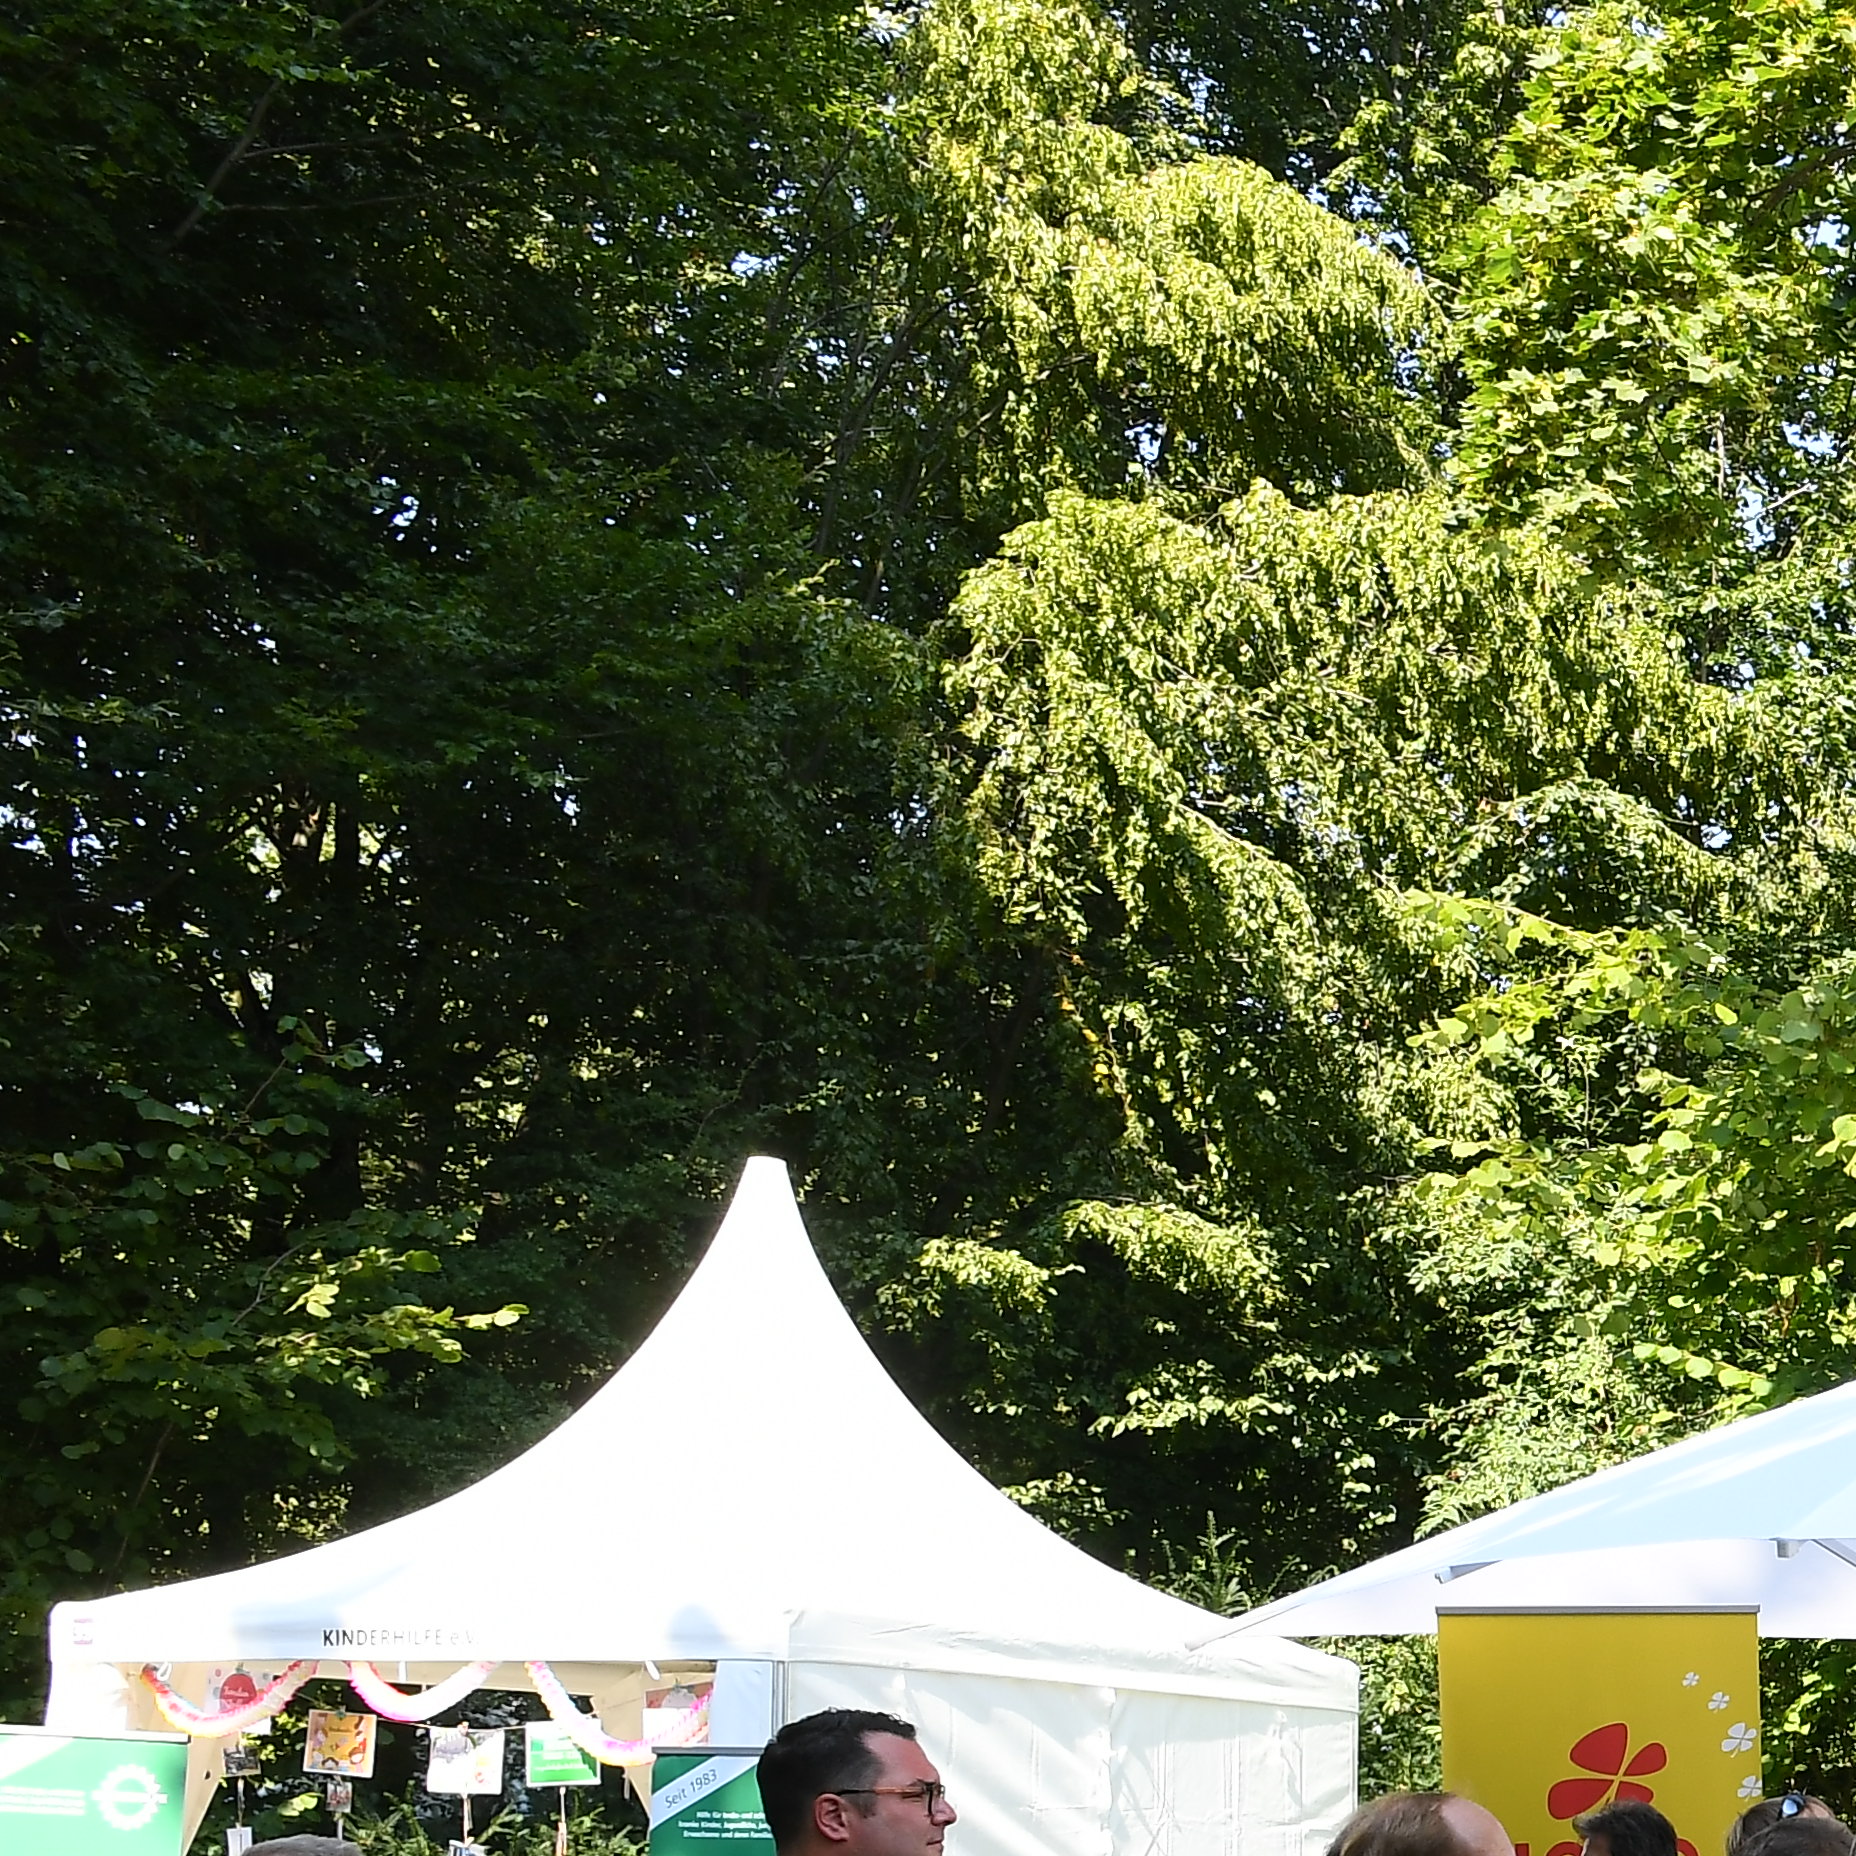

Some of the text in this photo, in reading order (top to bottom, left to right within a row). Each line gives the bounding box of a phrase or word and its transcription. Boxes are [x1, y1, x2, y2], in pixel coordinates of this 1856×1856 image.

[322, 1628, 443, 1647] KINDERHILFE
[664, 1768, 717, 1809] Seit 1983
